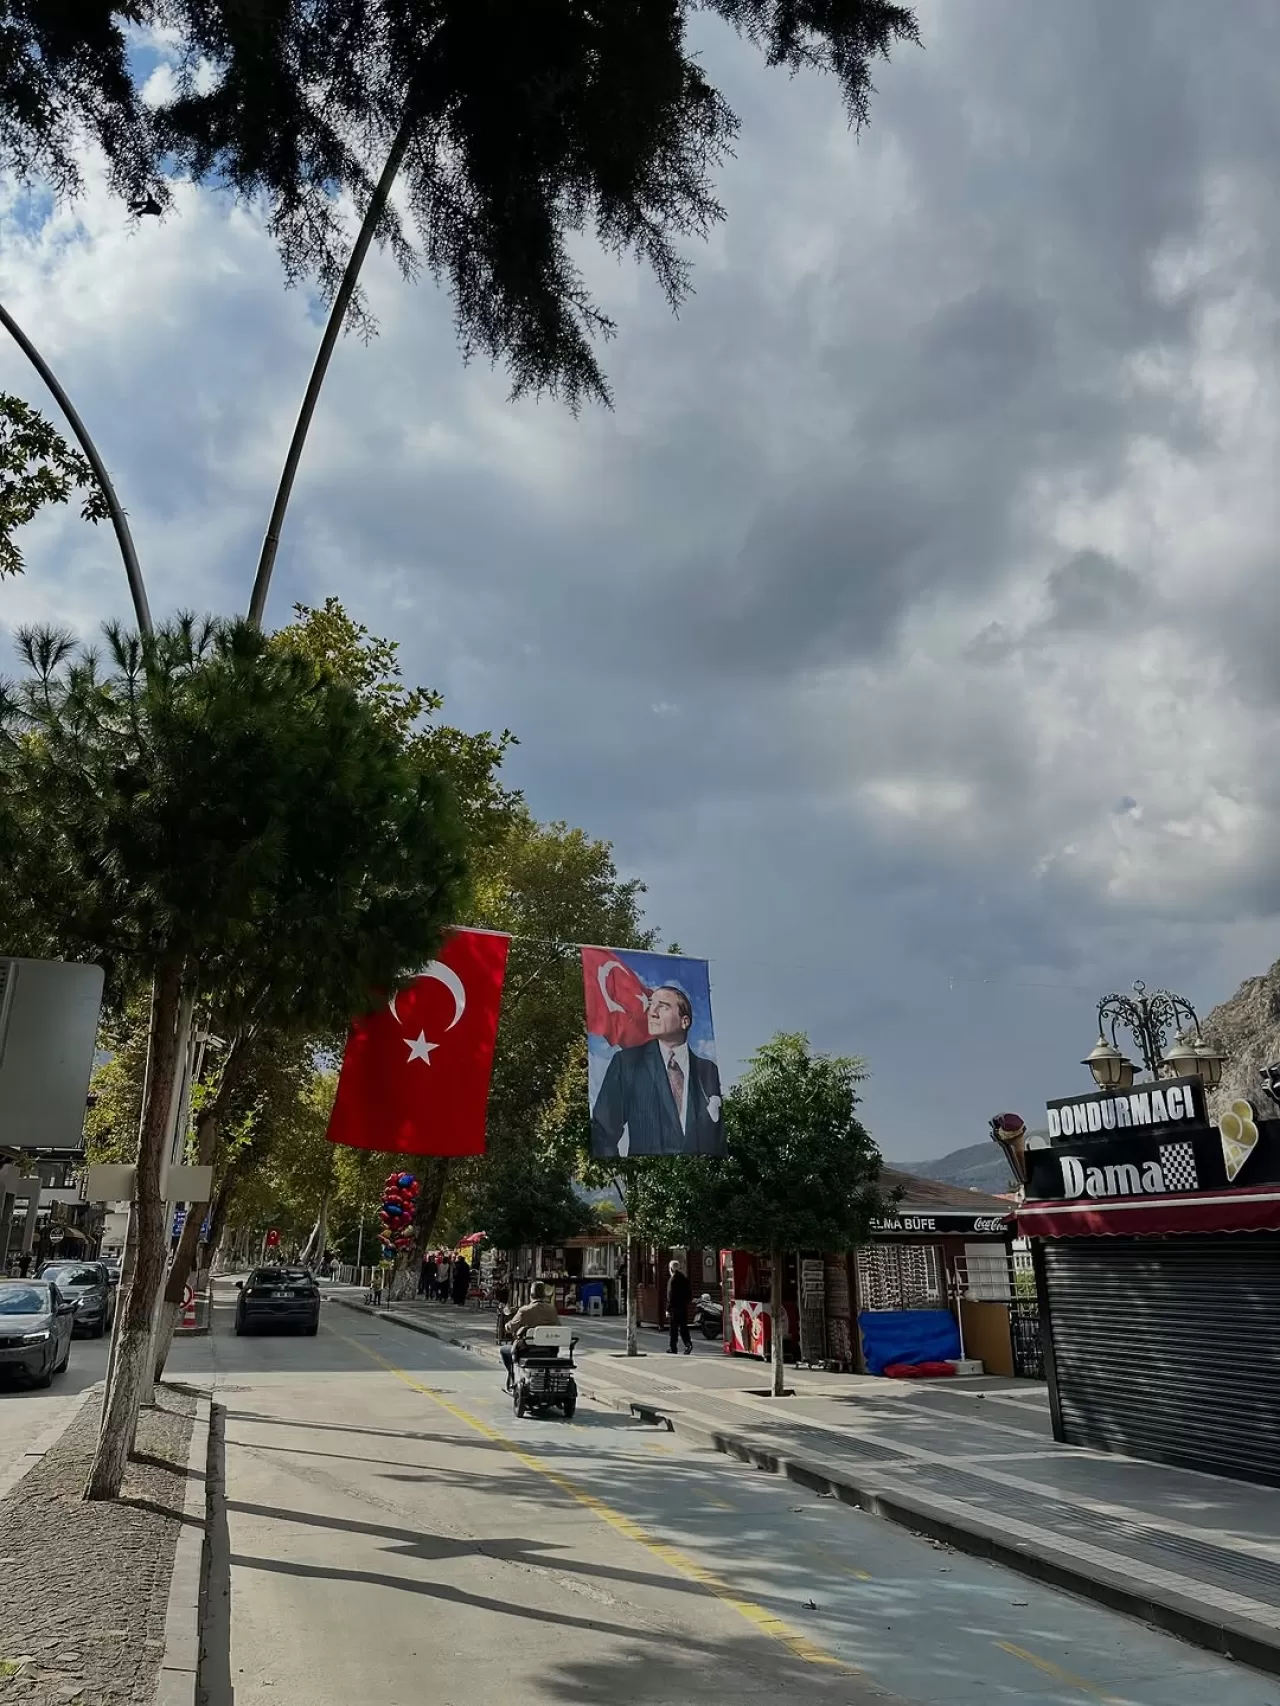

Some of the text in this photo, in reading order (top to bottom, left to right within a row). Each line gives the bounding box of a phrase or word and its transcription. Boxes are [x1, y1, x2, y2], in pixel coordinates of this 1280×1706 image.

[1047, 1085, 1195, 1138] DONDURMACI
[1059, 1155, 1166, 1199] Dama
[904, 1216, 936, 1230] BÜFE
